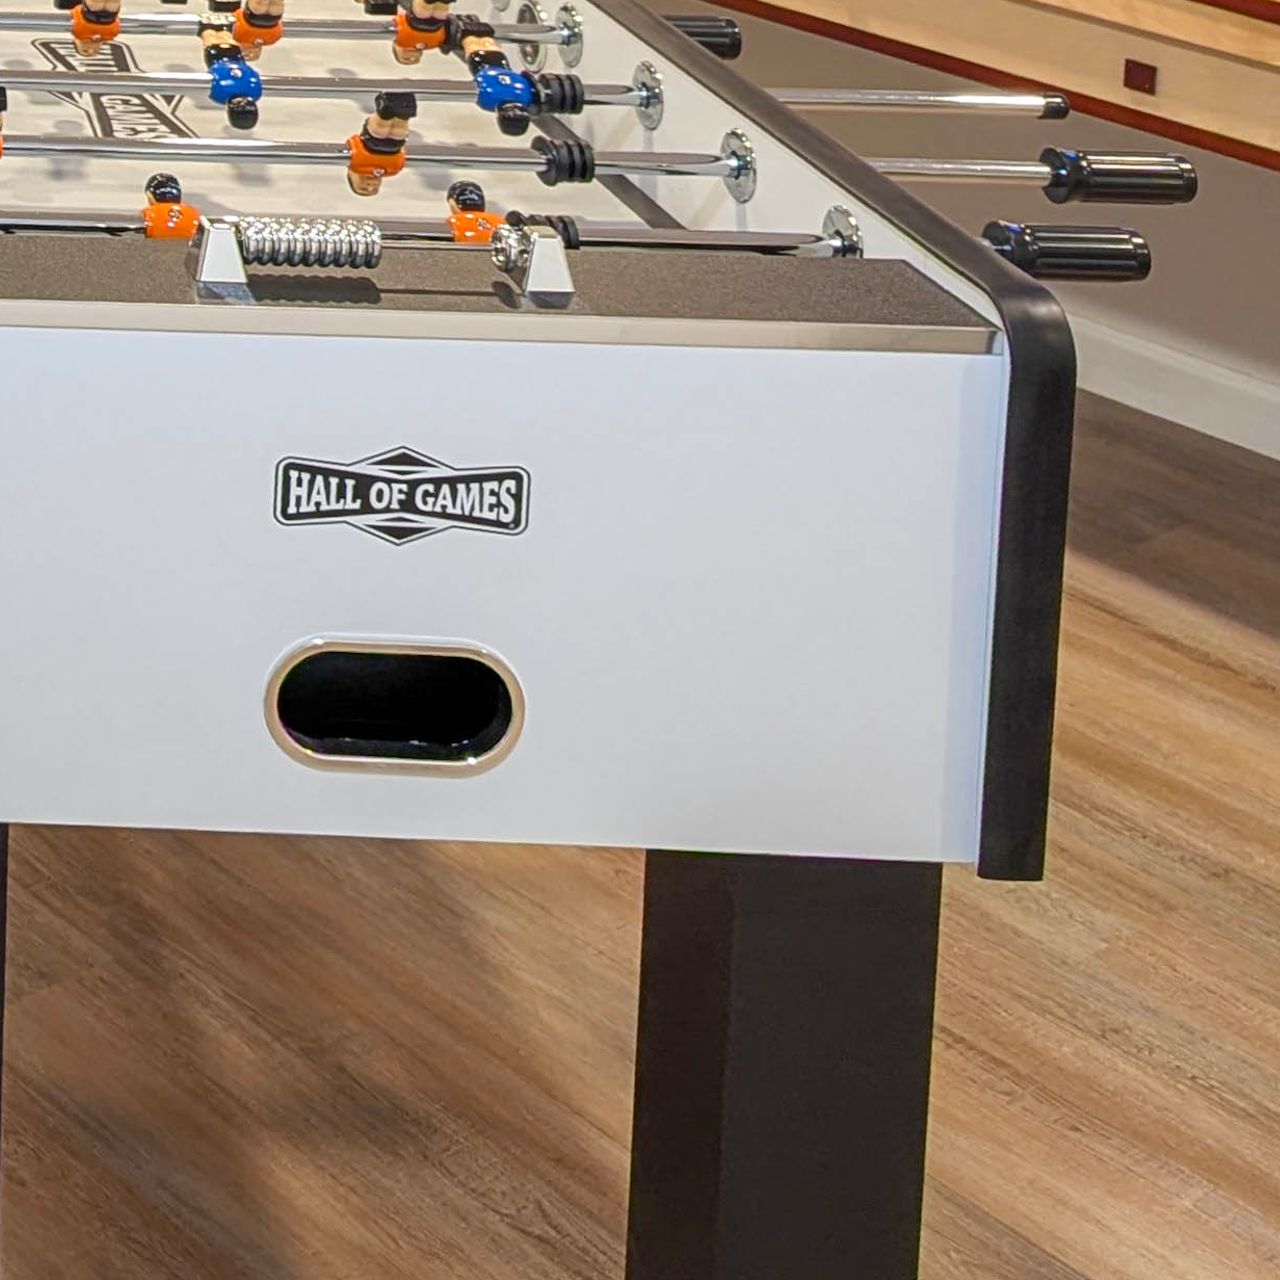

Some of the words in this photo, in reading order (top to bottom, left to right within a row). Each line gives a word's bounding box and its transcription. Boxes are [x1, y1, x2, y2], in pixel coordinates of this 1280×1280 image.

[287, 468, 362, 514] HALL
[369, 481, 409, 511] OF
[415, 478, 517, 524] GAMES
